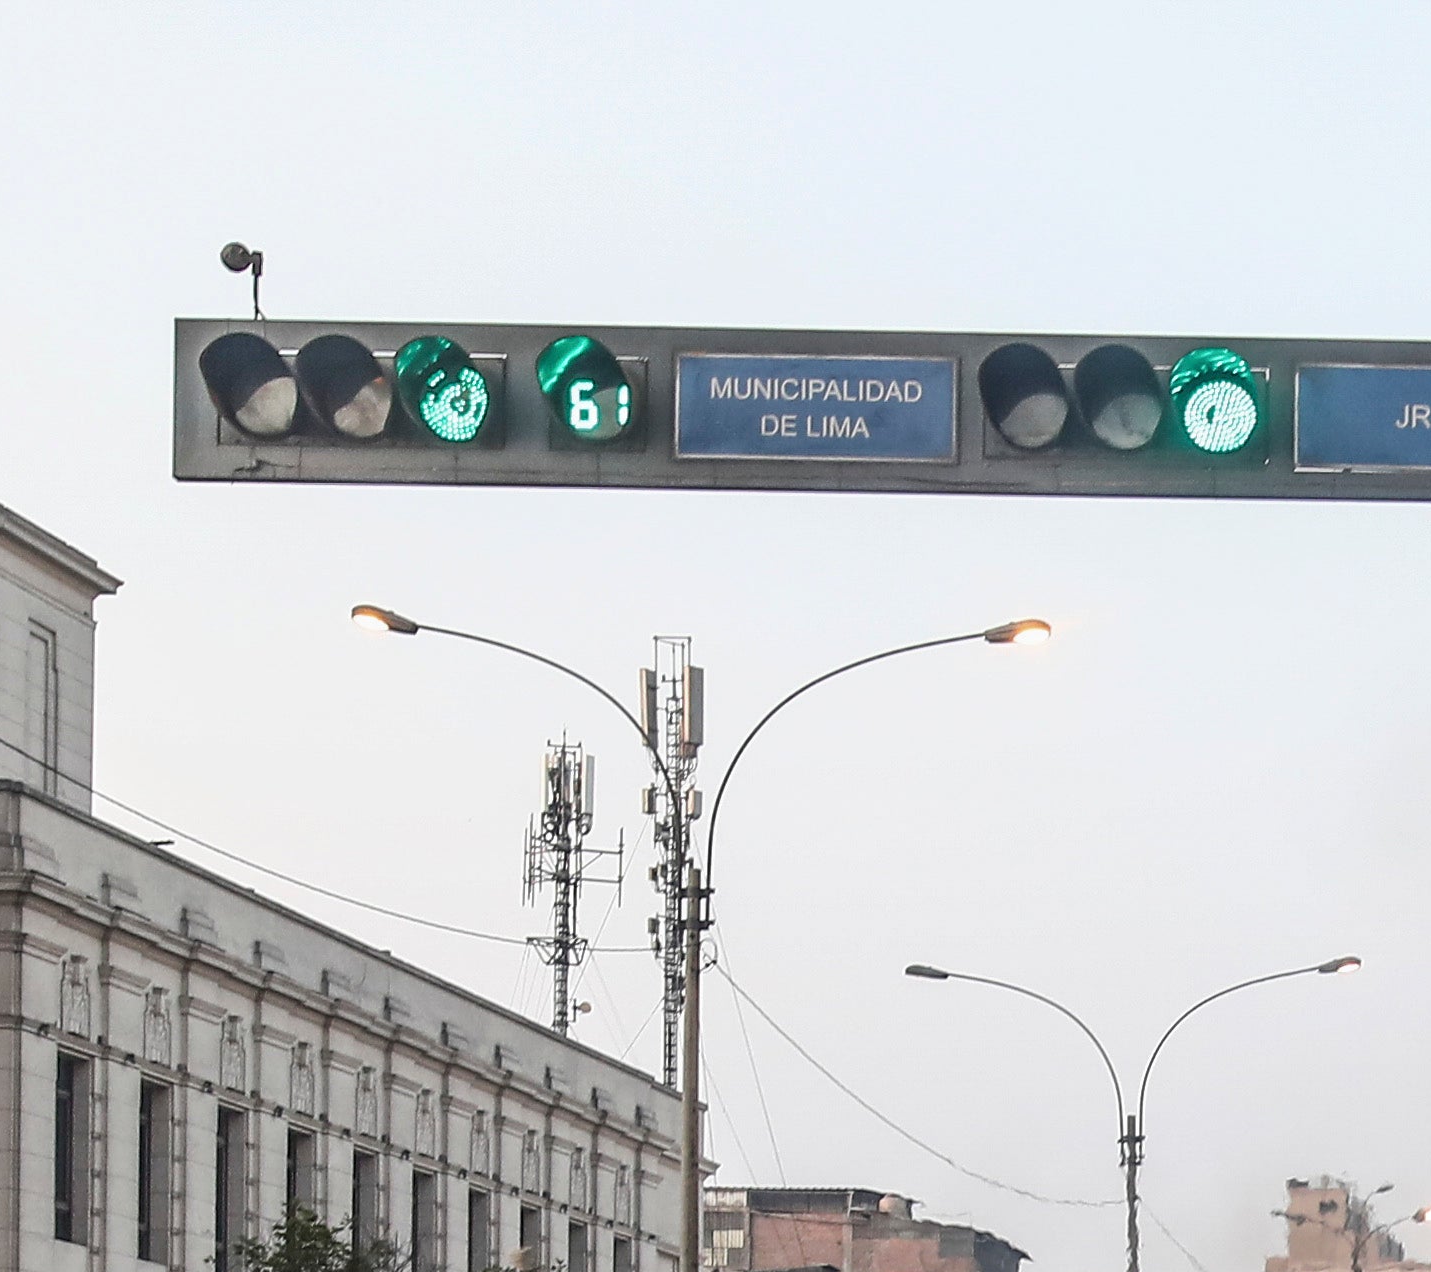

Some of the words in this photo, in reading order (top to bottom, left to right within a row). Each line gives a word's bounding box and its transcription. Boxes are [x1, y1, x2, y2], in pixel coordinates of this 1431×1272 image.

[710, 376, 923, 403] MUNICIPALIDAD
[761, 414, 798, 437] DE
[807, 414, 870, 438] LIMA
